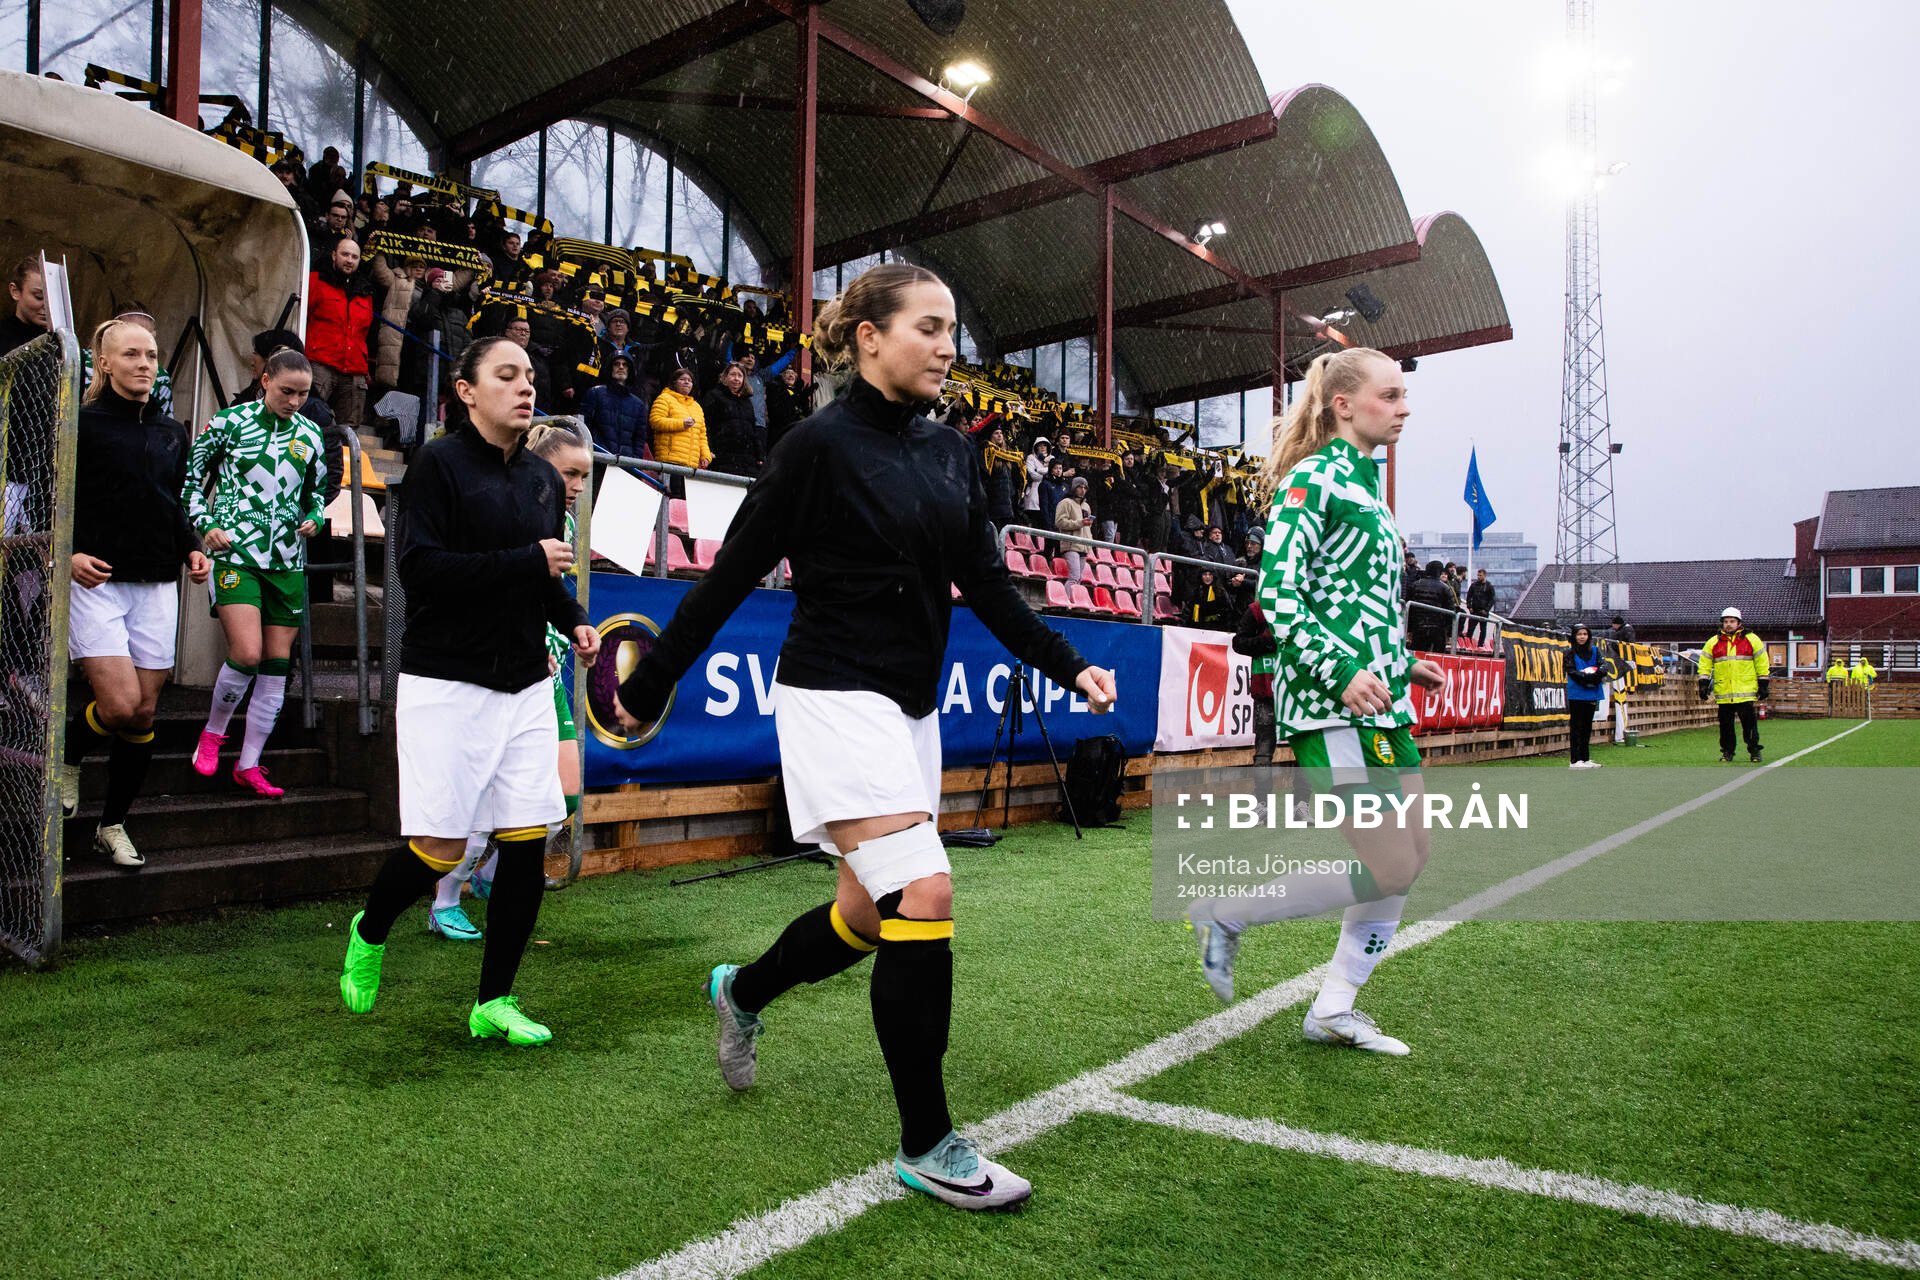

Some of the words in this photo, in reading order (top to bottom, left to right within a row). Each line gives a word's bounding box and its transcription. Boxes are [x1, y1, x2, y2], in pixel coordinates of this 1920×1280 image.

[388, 165, 453, 191] NORDIN
[380, 237, 404, 249] AIK
[417, 244, 442, 255] AIK
[455, 251, 480, 263] AIK
[986, 663, 1115, 714] CUP
[1424, 668, 1501, 718] AUHA
